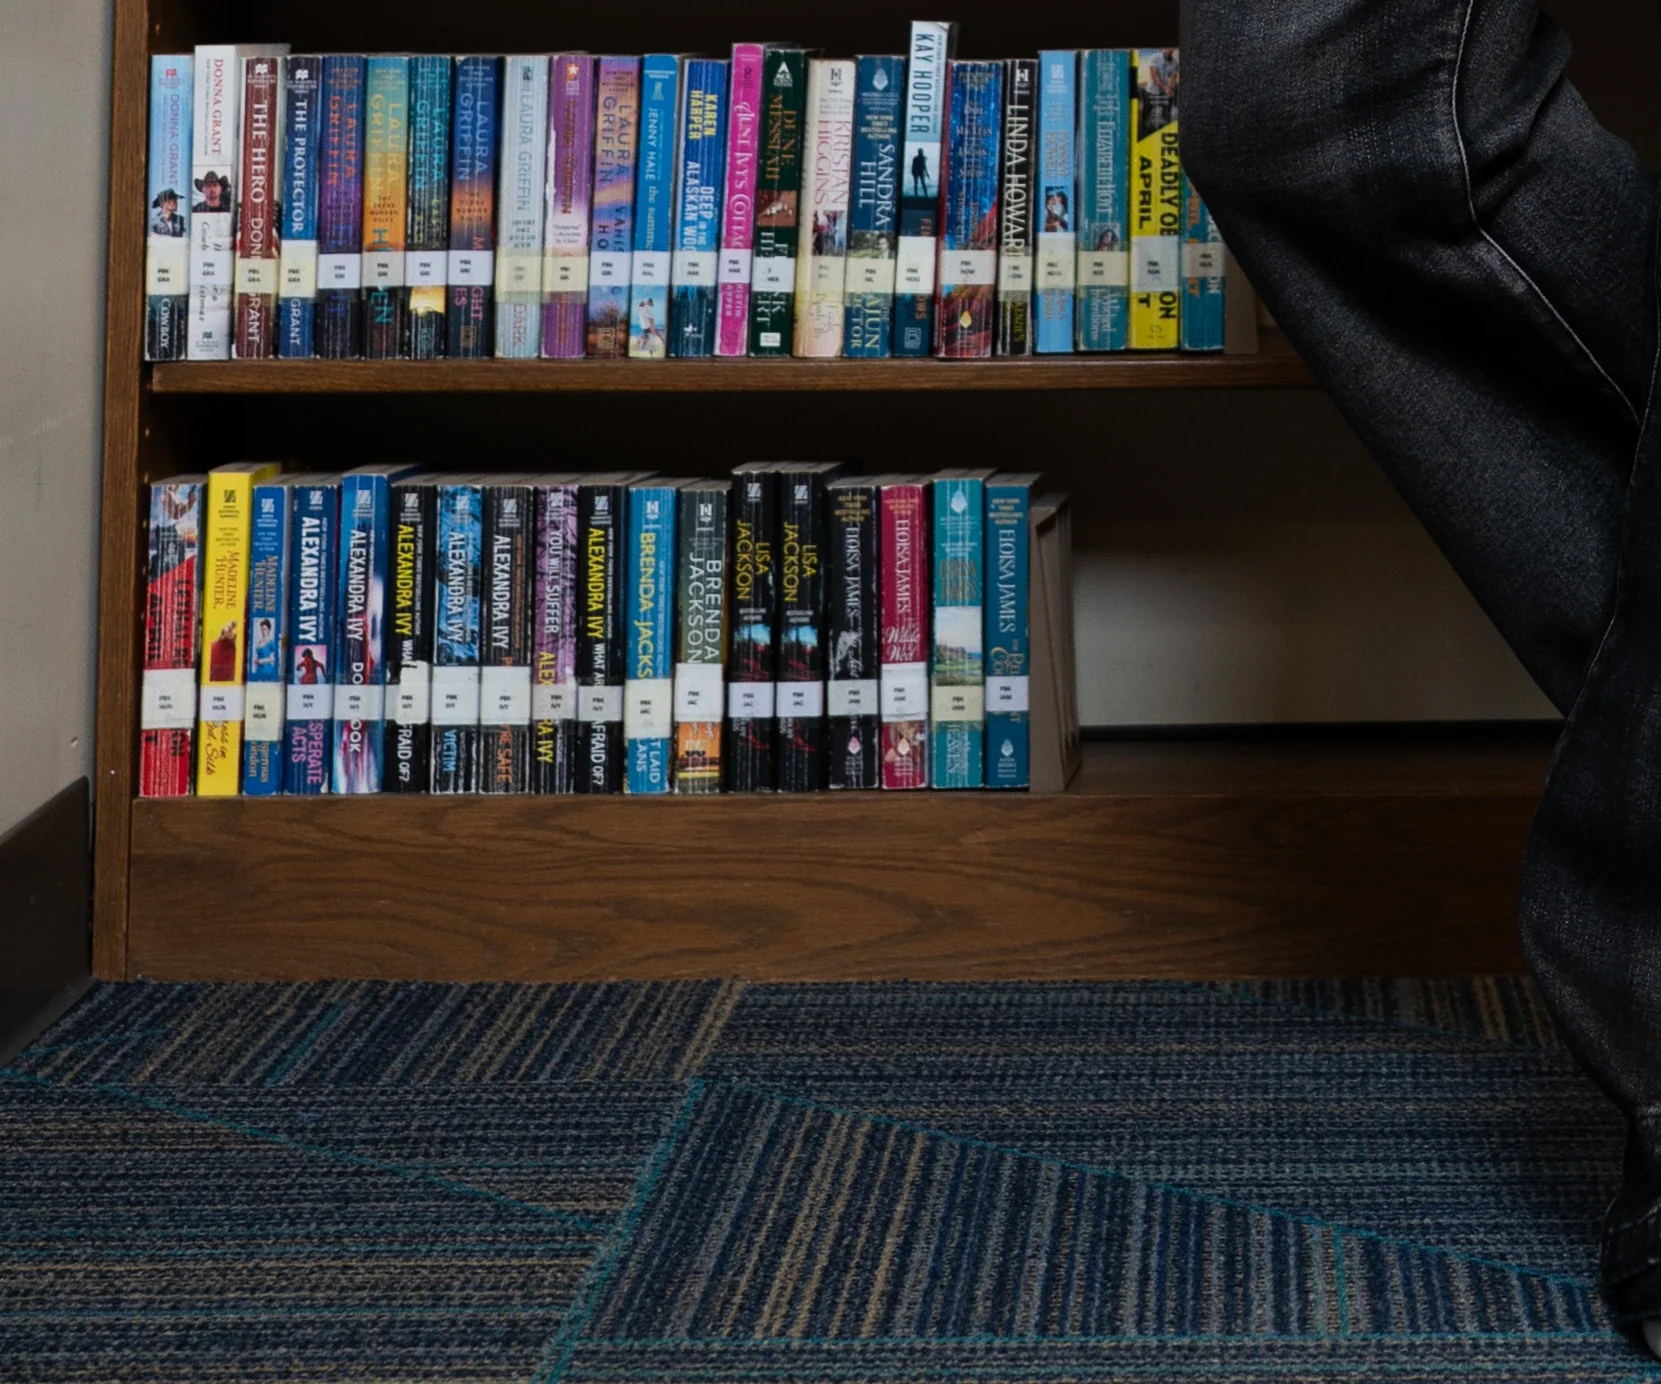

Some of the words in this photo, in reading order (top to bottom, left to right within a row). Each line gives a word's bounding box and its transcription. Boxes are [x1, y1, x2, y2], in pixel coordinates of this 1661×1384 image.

[915, 34, 933, 62] KAY
[211, 59, 224, 105] DONNA
[911, 69, 931, 133] HOOPER
[209, 109, 223, 156] GRANT
[252, 101, 267, 139] THE
[295, 98, 307, 132] THE
[647, 107, 660, 147] JENNY
[688, 90, 704, 140] HARPER
[704, 94, 717, 136] KAREN
[766, 95, 783, 180] MESSIAH
[781, 110, 796, 166] DUNE
[600, 96, 617, 184] GRIFFIN
[617, 105, 632, 177] LAURA
[250, 148, 265, 203] HERO
[292, 137, 305, 232] PROTECTOR
[645, 151, 658, 181] HALE
[858, 160, 877, 209] HILL
[875, 143, 895, 226] SANDRA
[1160, 133, 1177, 206] DEADLY
[684, 161, 699, 221] ALASKAN
[700, 186, 714, 220] DEEP
[1138, 155, 1152, 230] APRIL
[300, 517, 321, 608] ALEXANDRA
[548, 531, 561, 555] YOU
[736, 519, 752, 600] JACKSON
[755, 542, 770, 575] LISA
[1000, 530, 1016, 579] ELOISA
[226, 551, 239, 610] MADELINE
[547, 557, 559, 582] WILL
[298, 615, 317, 642] IVY
[545, 585, 561, 633] SUFFER
[688, 551, 703, 664] JACKSON
[704, 559, 721, 660] BRENDA
[997, 583, 1016, 632] JAMES
[291, 726, 307, 764] ACTS
[443, 730, 457, 772] VICTIM
